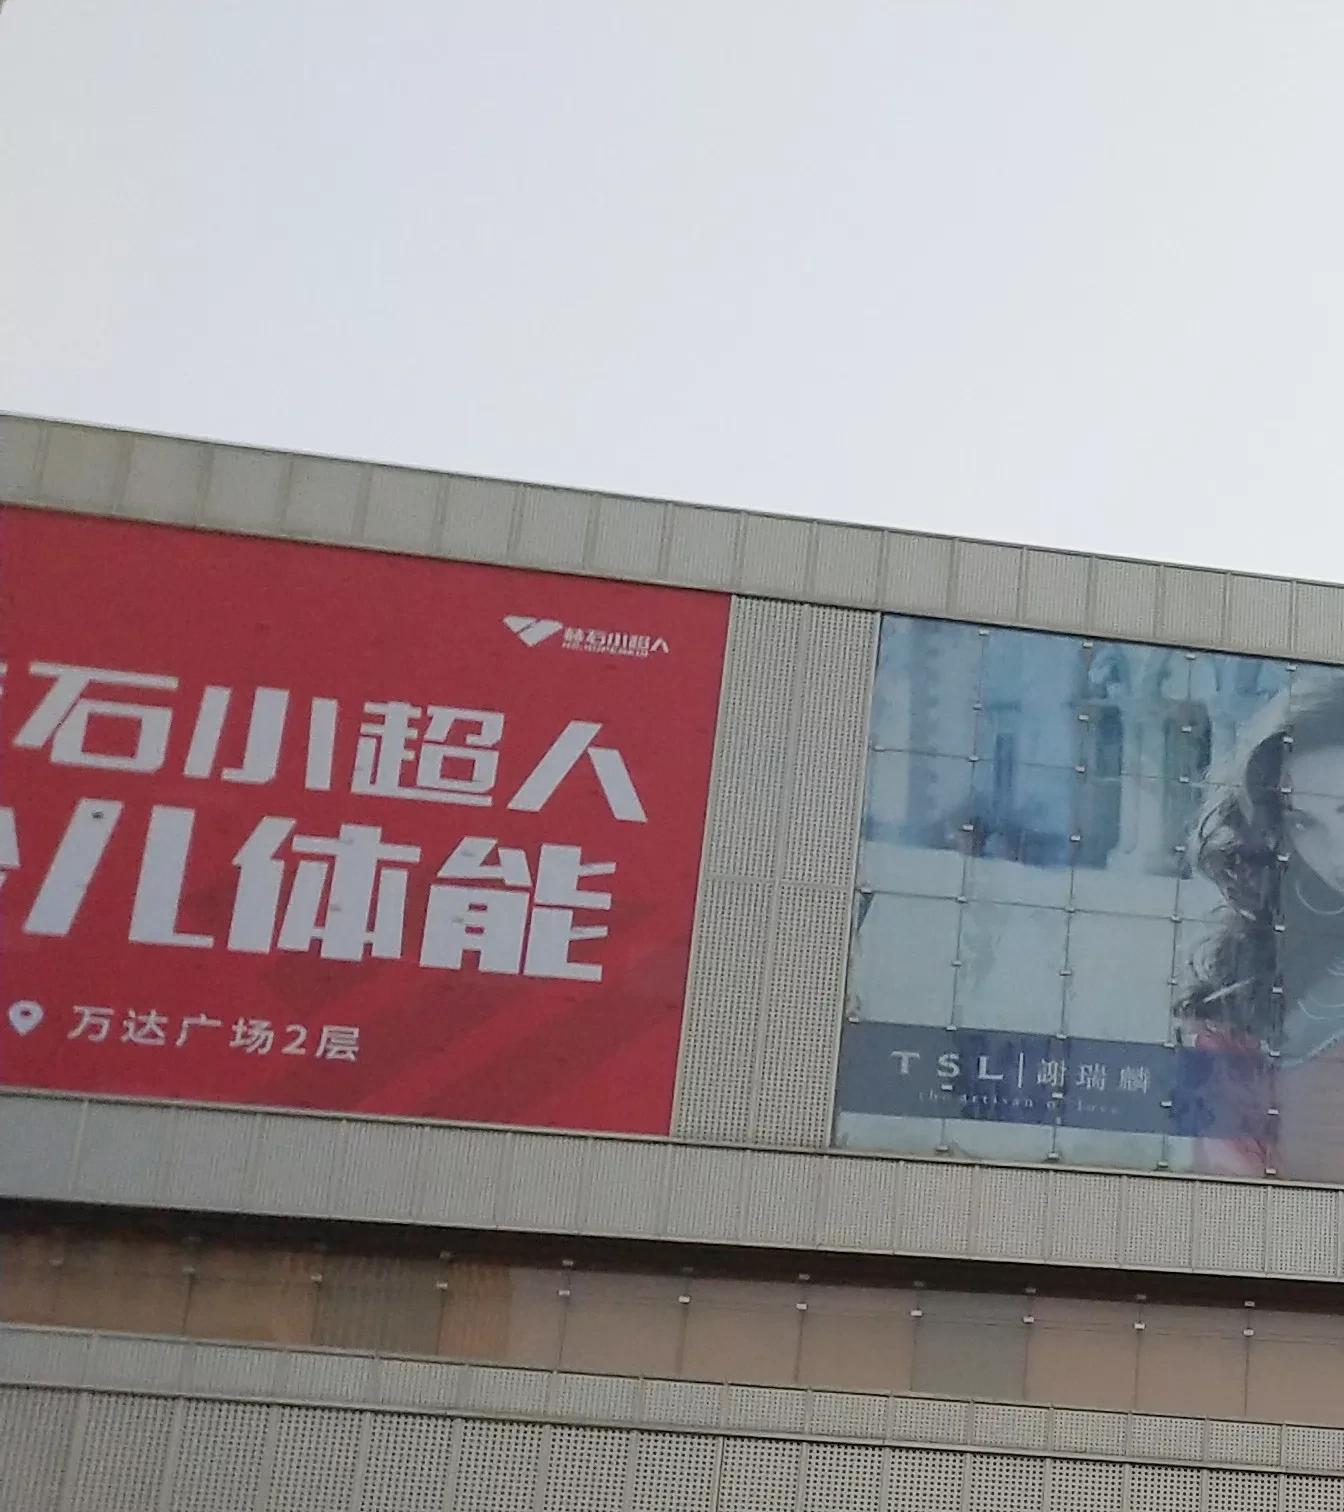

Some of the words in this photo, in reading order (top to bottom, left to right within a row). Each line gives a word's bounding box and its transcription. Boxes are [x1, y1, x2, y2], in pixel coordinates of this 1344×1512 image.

[0, 661, 647, 823] 石小超人
[0, 798, 617, 982] 儿体能
[67, 1005, 361, 1062] 万达广场2层
[890, 1050, 1005, 1081] TSL
